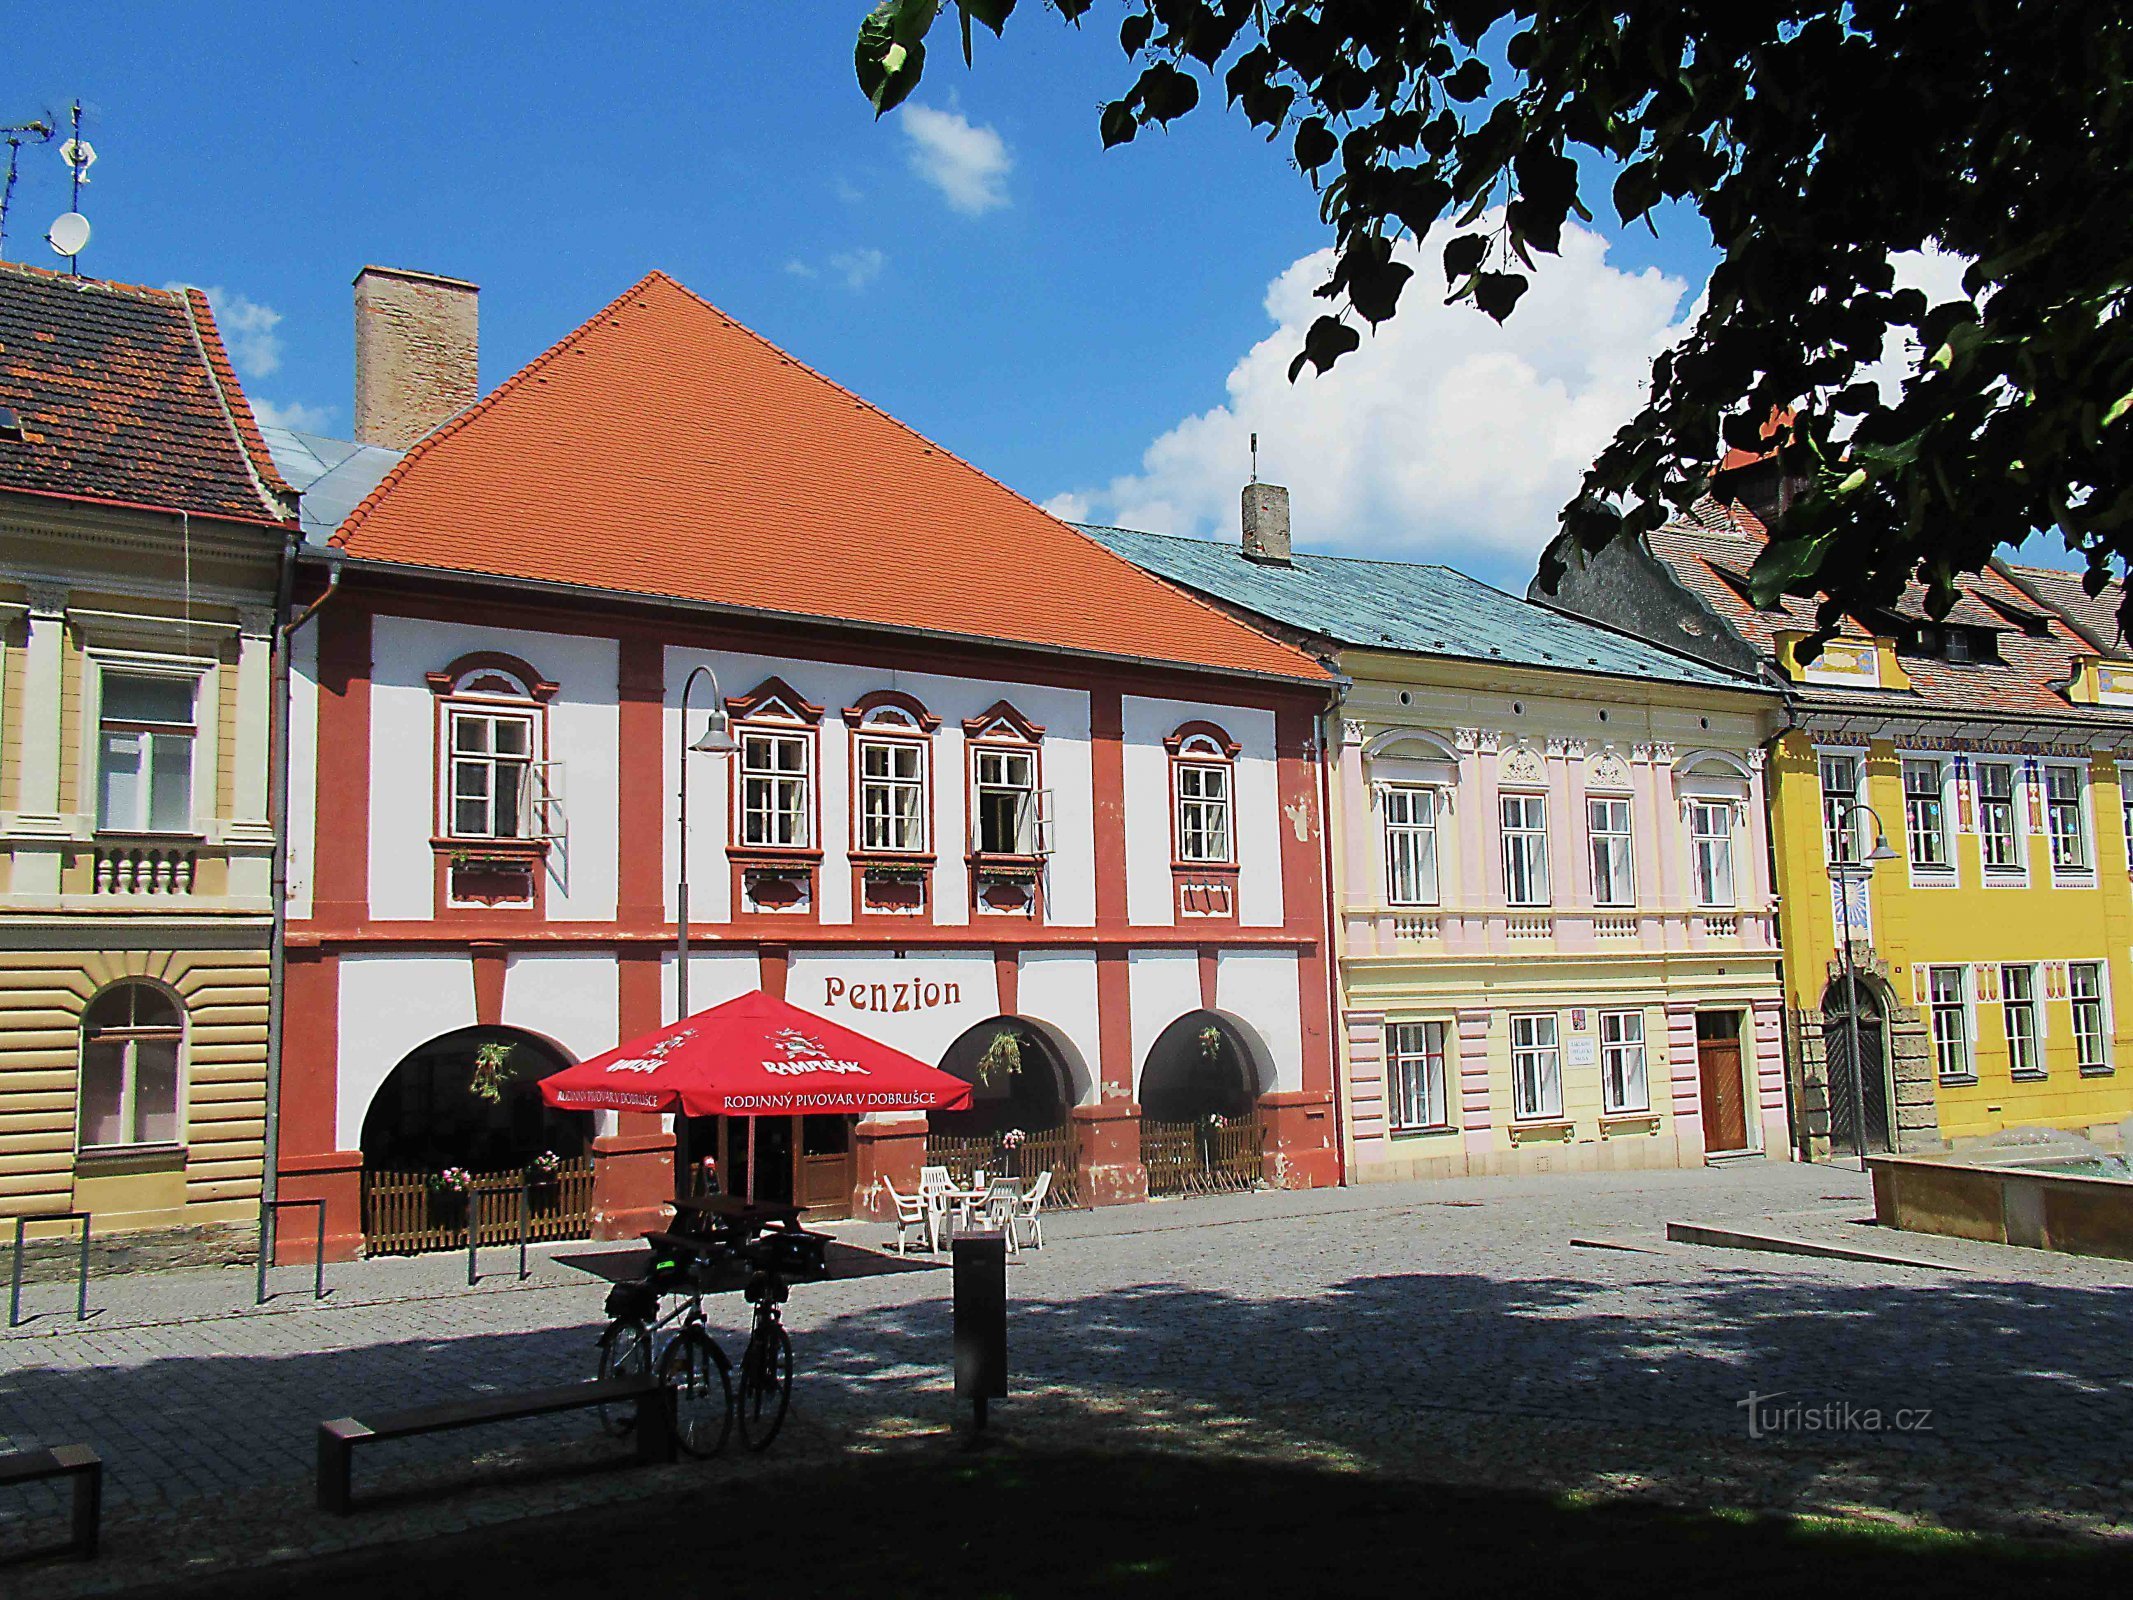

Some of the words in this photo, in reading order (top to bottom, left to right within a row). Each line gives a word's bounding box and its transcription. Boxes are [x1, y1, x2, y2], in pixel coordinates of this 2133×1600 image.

[824, 977, 961, 1012] Penzion
[724, 1091, 793, 1109] RODINNÝ
[796, 1093, 854, 1106] PIVOVAR
[856, 1093, 865, 1104] V
[867, 1090, 936, 1105] DOBRUŠCE
